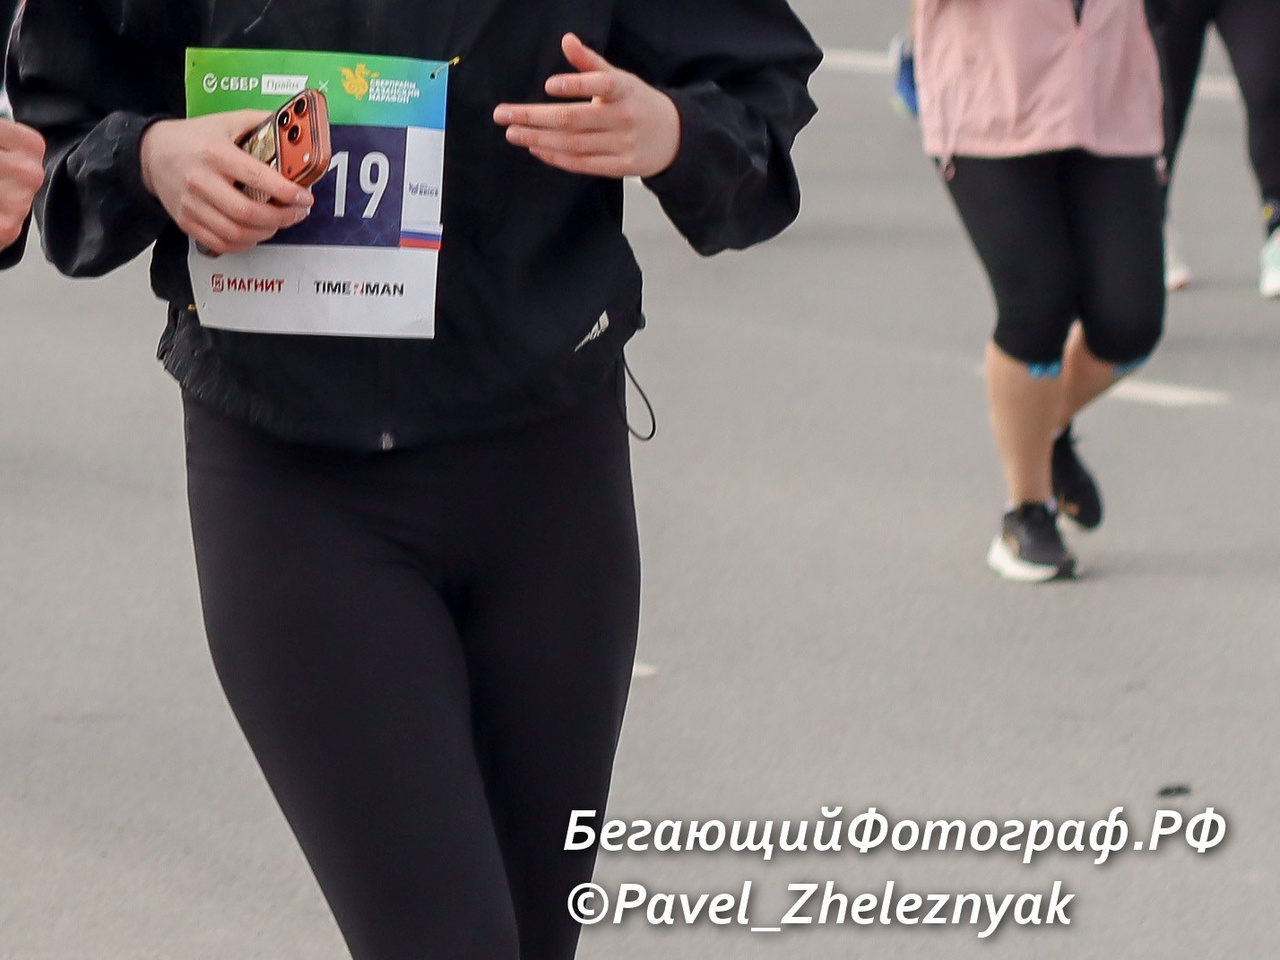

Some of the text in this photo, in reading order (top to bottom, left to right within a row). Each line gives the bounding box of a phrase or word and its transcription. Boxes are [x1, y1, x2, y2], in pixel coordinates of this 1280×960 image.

[220, 76, 259, 91] СБЕР
[327, 150, 390, 219] 19
[227, 278, 285, 293] МАГНИТ
